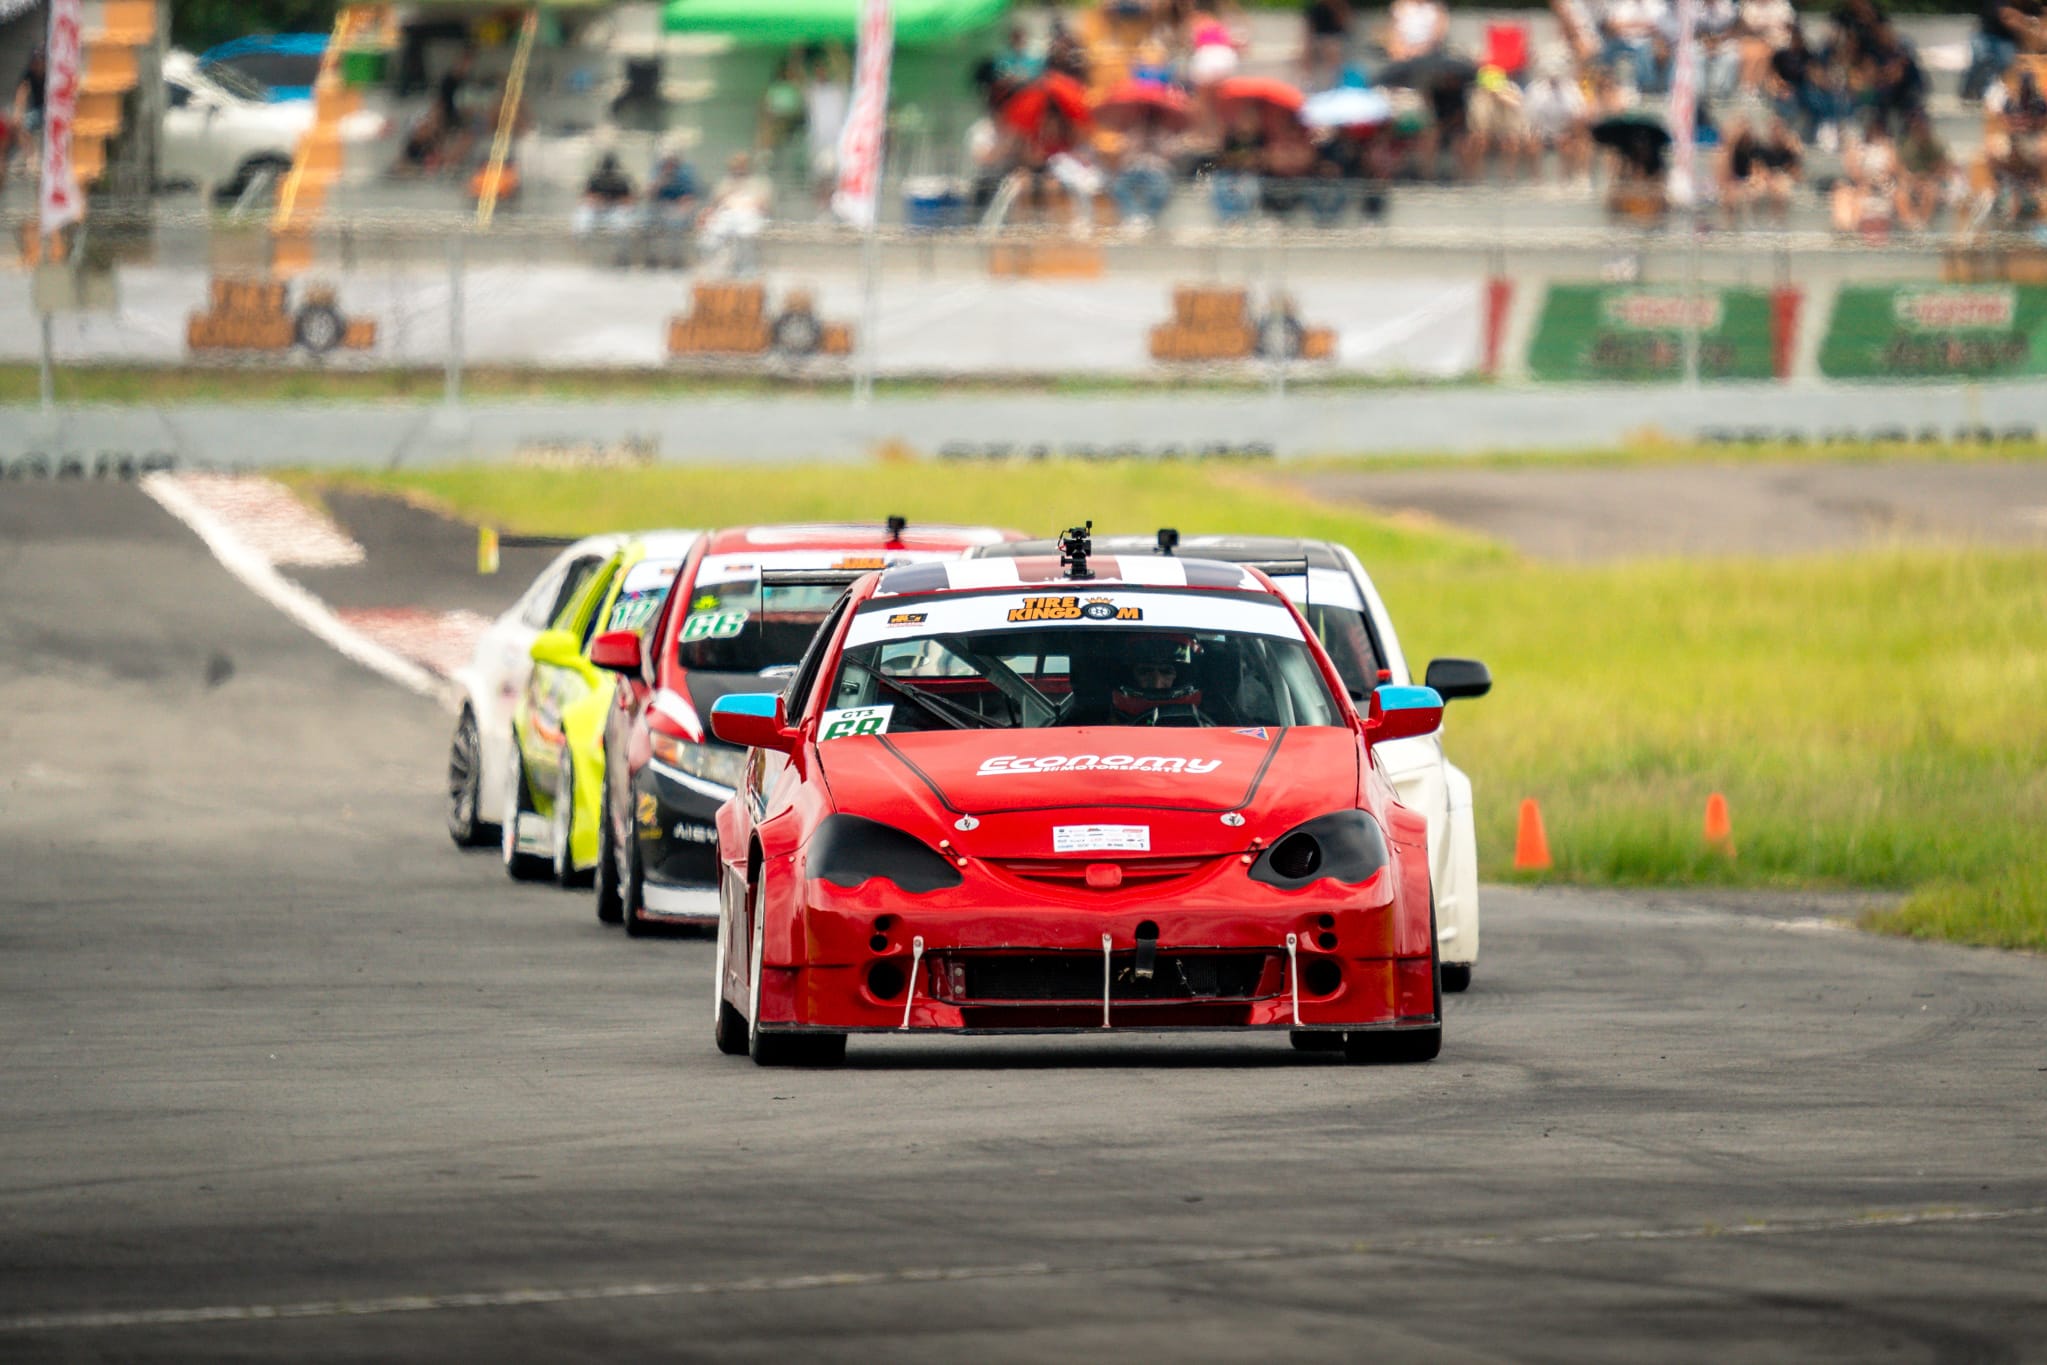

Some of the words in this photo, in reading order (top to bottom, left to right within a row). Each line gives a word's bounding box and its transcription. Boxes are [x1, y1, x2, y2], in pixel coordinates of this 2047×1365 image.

[1023, 597, 1079, 609] TIRE
[1008, 606, 1142, 621] KINGDOM
[681, 609, 747, 640] 66
[841, 709, 875, 719] GT3
